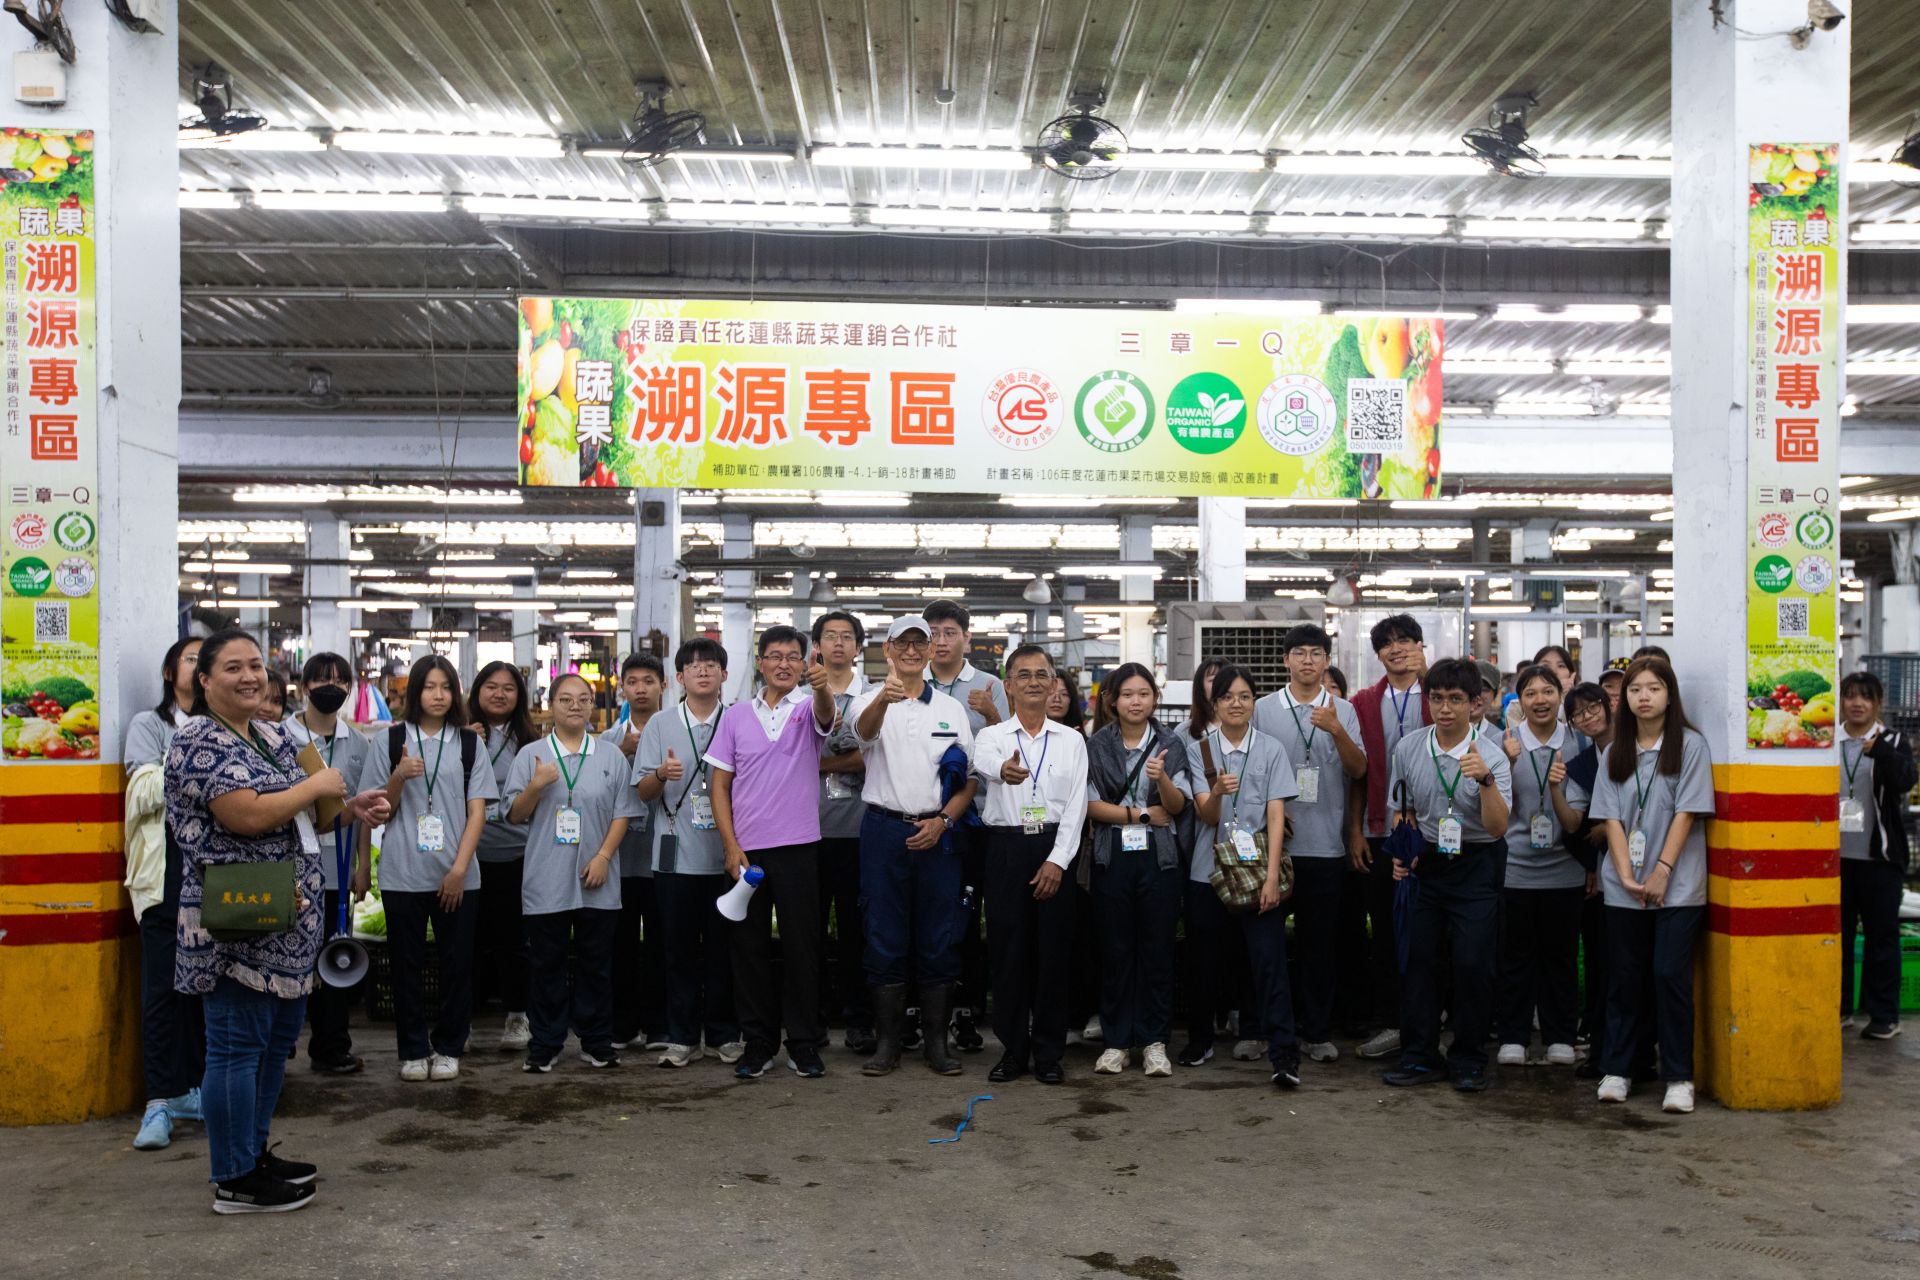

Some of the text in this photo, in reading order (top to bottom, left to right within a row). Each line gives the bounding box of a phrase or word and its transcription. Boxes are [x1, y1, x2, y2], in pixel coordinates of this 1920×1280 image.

[19, 207, 85, 236] 蔬果
[1770, 219, 1830, 247] 蔬果
[631, 319, 958, 349] 保證責任花蓮縣蔬菜運銷合作社
[25, 243, 79, 461] 溯源專區
[1775, 253, 1823, 462] 溯源專區
[575, 360, 613, 445] 蔬果
[628, 366, 957, 446] 溯源專區
[1167, 407, 1212, 417] TAIWAN
[1167, 418, 1211, 427] ORGANIC
